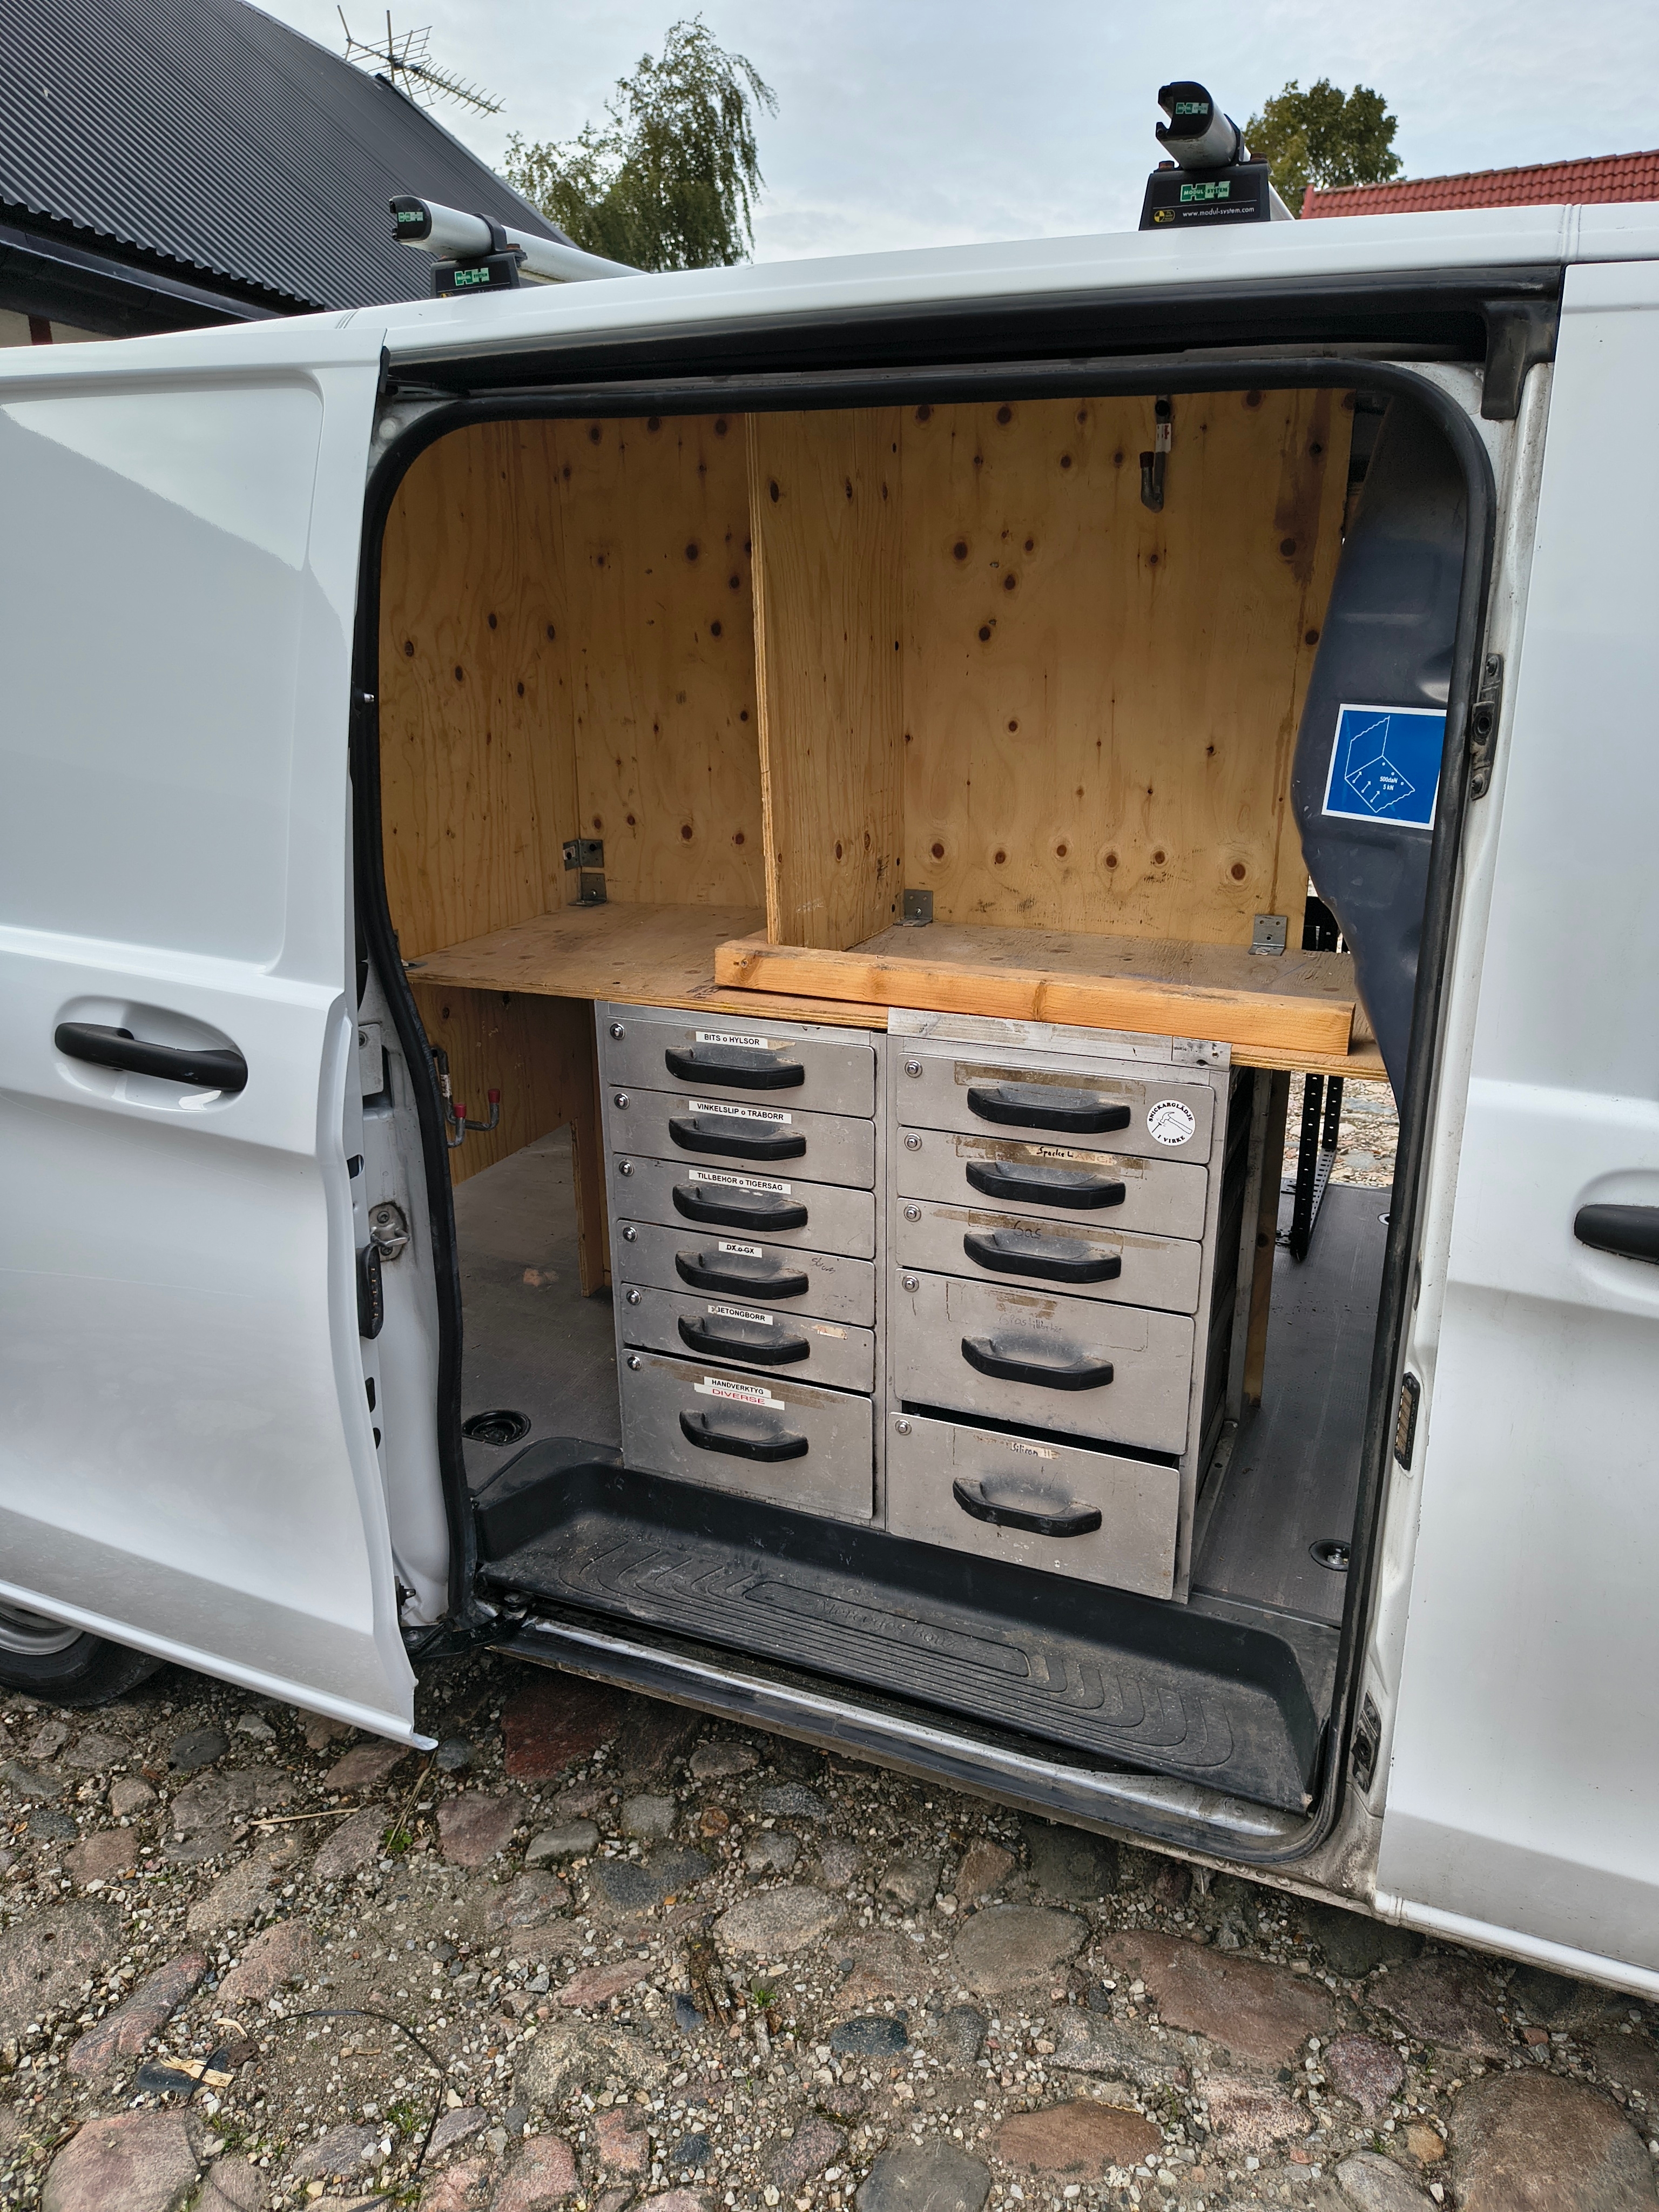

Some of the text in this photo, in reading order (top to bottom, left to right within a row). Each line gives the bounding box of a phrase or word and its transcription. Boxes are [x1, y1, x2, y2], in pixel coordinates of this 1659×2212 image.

[704, 1034, 721, 1042] BITS
[729, 1036, 760, 1046] HYLSOR
[697, 1103, 739, 1114] VINKELSLIP
[747, 1109, 784, 1121] TRÄBORR
[1149, 1102, 1193, 1122] SNICKARGLÄDJE
[1163, 1135, 1186, 1143] VIRKE
[697, 1172, 738, 1184] TILLBEHÖR
[712, 1379, 764, 1395] HANDVERKTYG
[712, 1388, 766, 1405] DIVERSE
